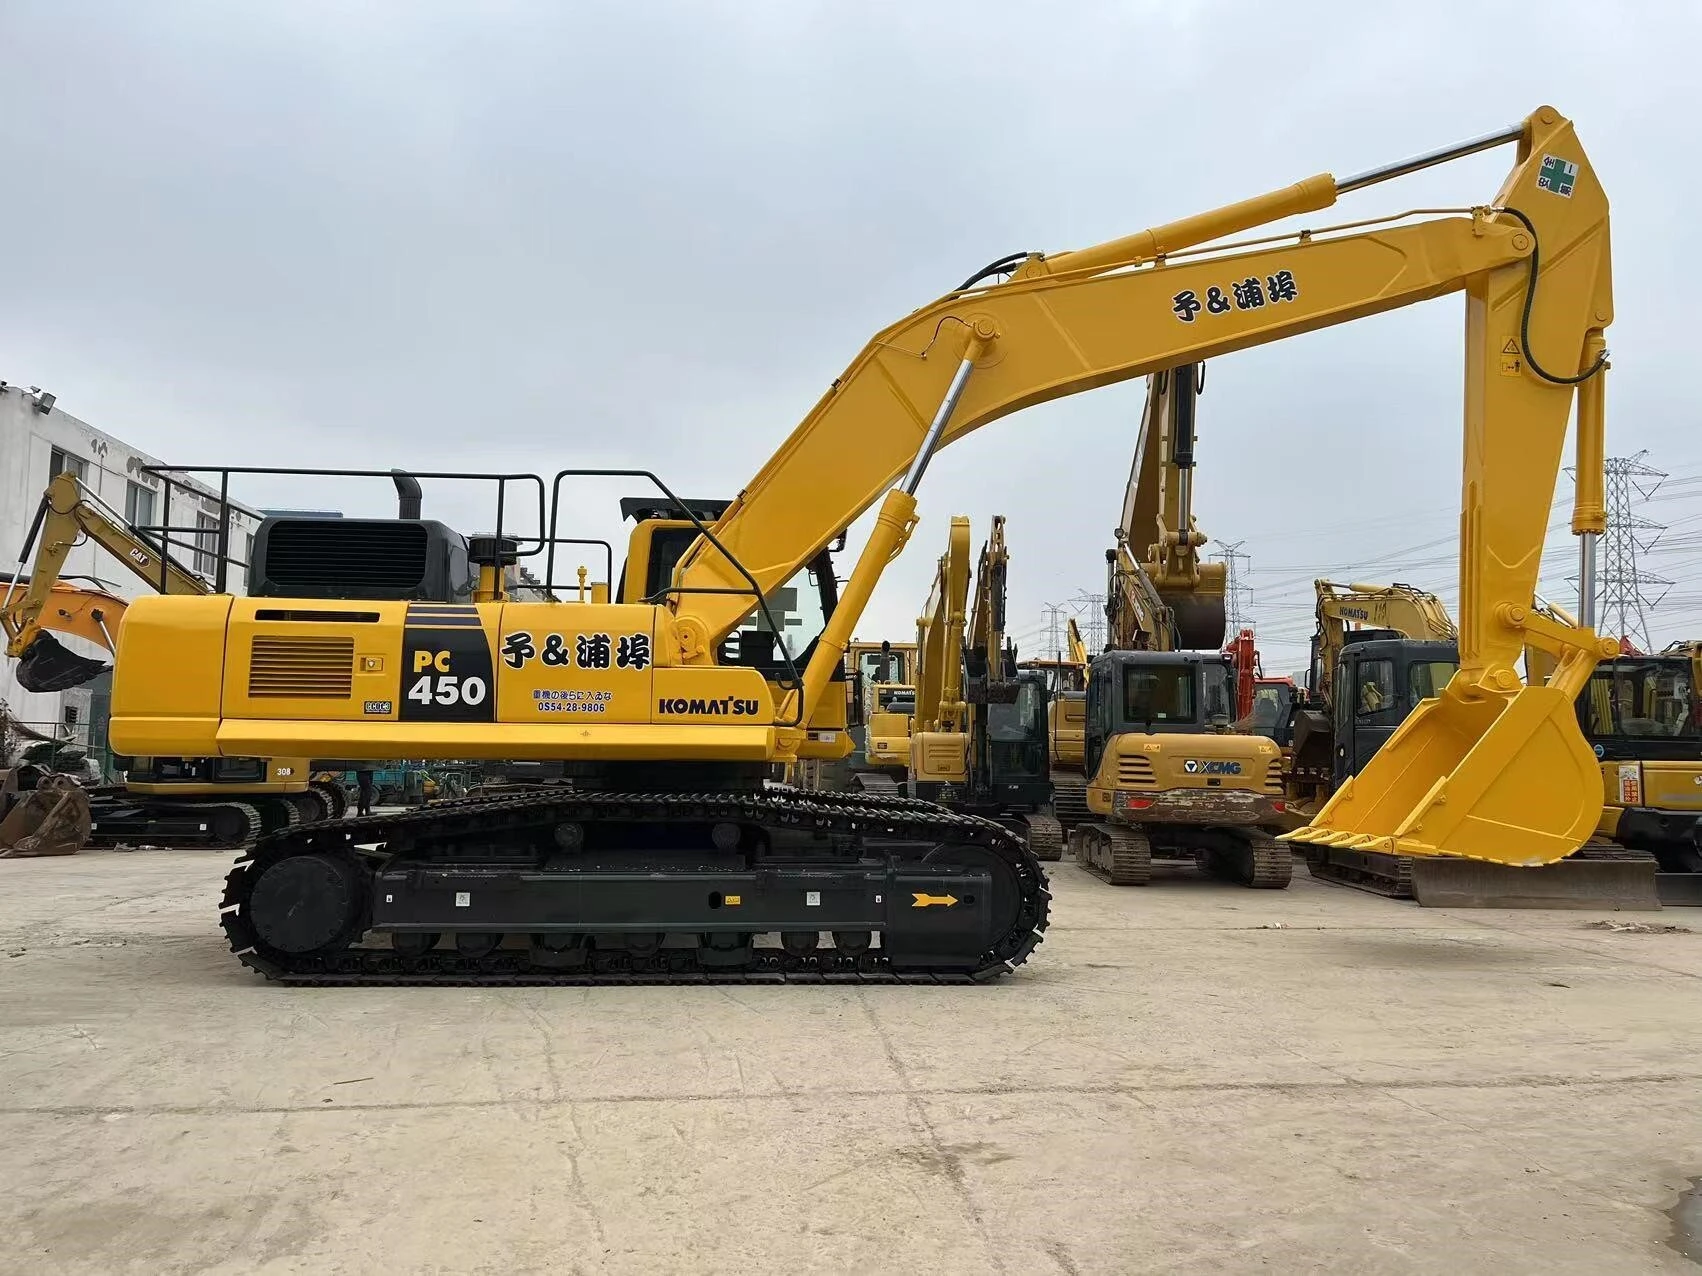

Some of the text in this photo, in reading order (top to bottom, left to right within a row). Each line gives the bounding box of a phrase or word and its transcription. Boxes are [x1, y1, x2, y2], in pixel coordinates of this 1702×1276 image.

[129, 547, 149, 563] CAT
[1339, 606, 1369, 620] KOMATSU
[413, 650, 451, 673] PC
[407, 675, 487, 706] 450
[658, 696, 759, 715] KOMATSU
[276, 767, 291, 776] 308
[1199, 761, 1242, 775] XCMG
